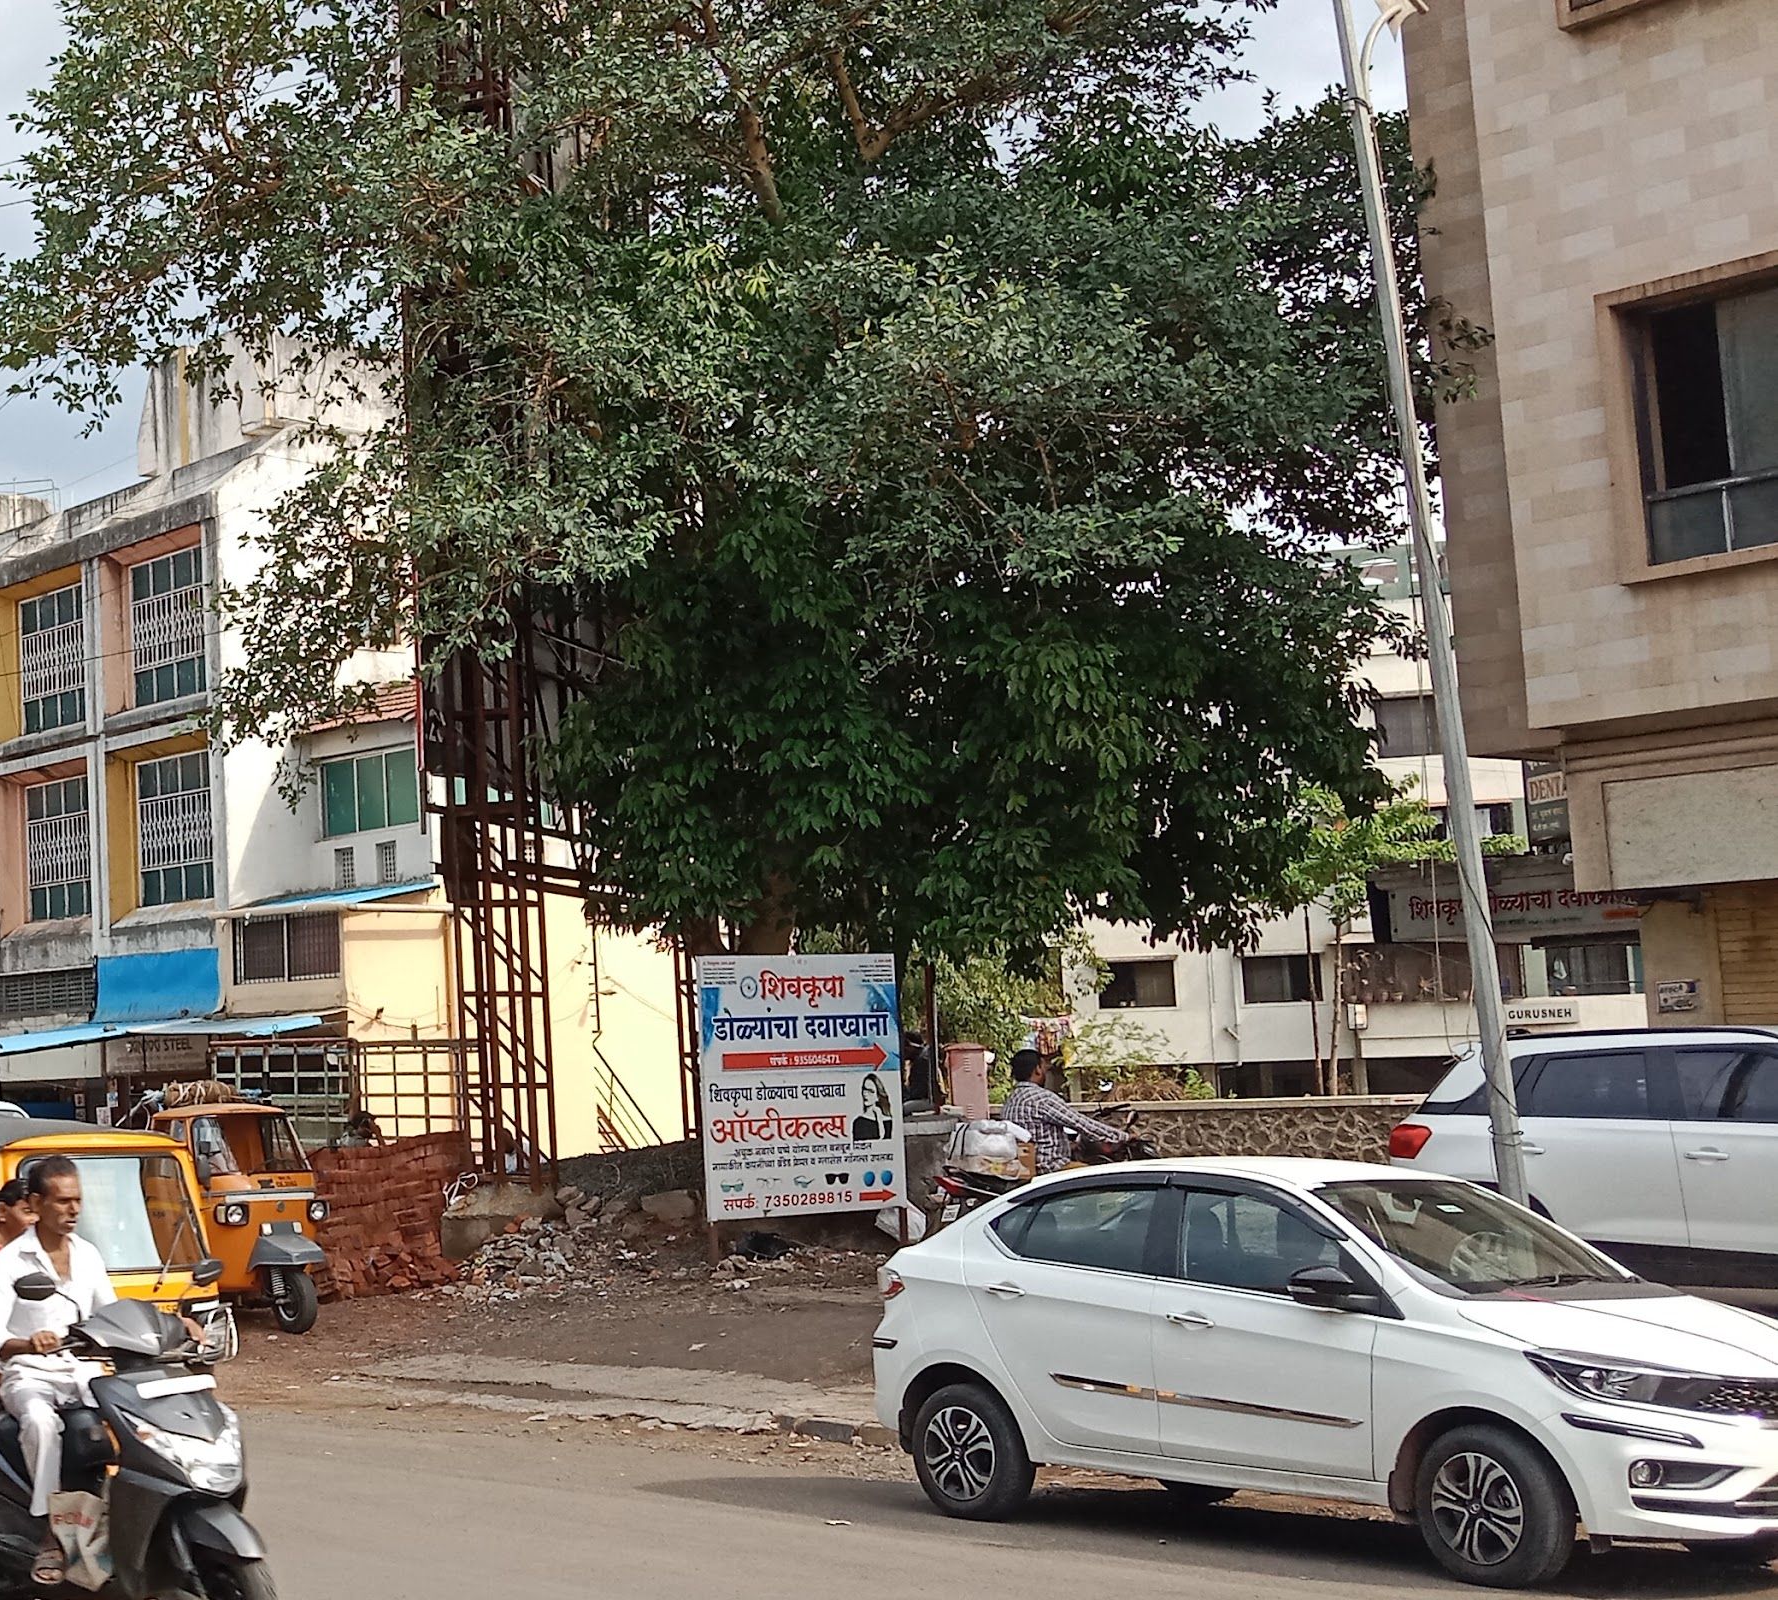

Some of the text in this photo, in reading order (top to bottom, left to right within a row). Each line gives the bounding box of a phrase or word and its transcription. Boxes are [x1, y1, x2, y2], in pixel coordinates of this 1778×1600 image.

[759, 970, 845, 1008] शिवकृपा
[712, 1007, 890, 1041] डोळ्यांचा दवाखाना
[1508, 1008, 1572, 1019] GURUSNEH
[163, 1037, 193, 1051] STEEL
[709, 1083, 752, 1107] शिवकृपा
[801, 1083, 846, 1099] दवाखाना
[710, 1107, 849, 1143] ऑप्टीकल्स
[765, 1191, 853, 1207] 7350289815
